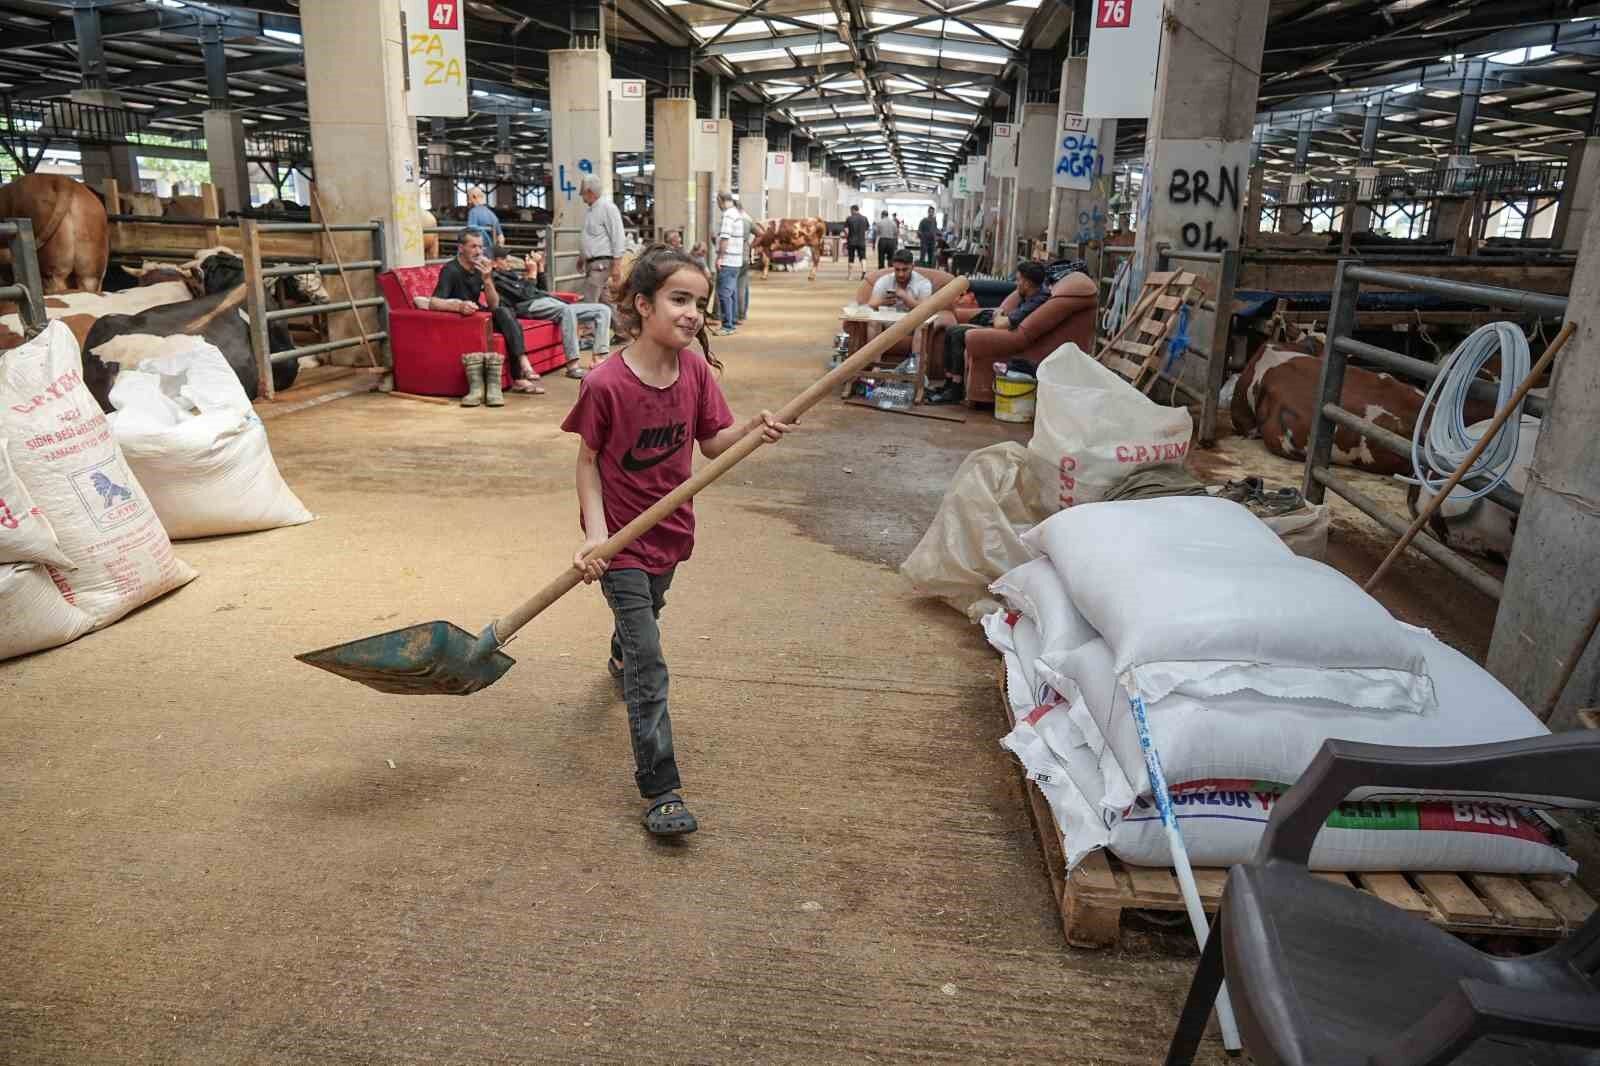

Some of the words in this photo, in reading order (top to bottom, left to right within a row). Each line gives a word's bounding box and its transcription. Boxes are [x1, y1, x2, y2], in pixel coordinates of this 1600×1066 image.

[432, 3, 454, 25] 47
[1102, 0, 1125, 23] 76
[409, 34, 444, 56] ZA
[424, 58, 464, 86] ZA
[1169, 165, 1240, 211] BRN
[635, 421, 688, 449] NIKE
[1115, 441, 1188, 464] C.P.YEM
